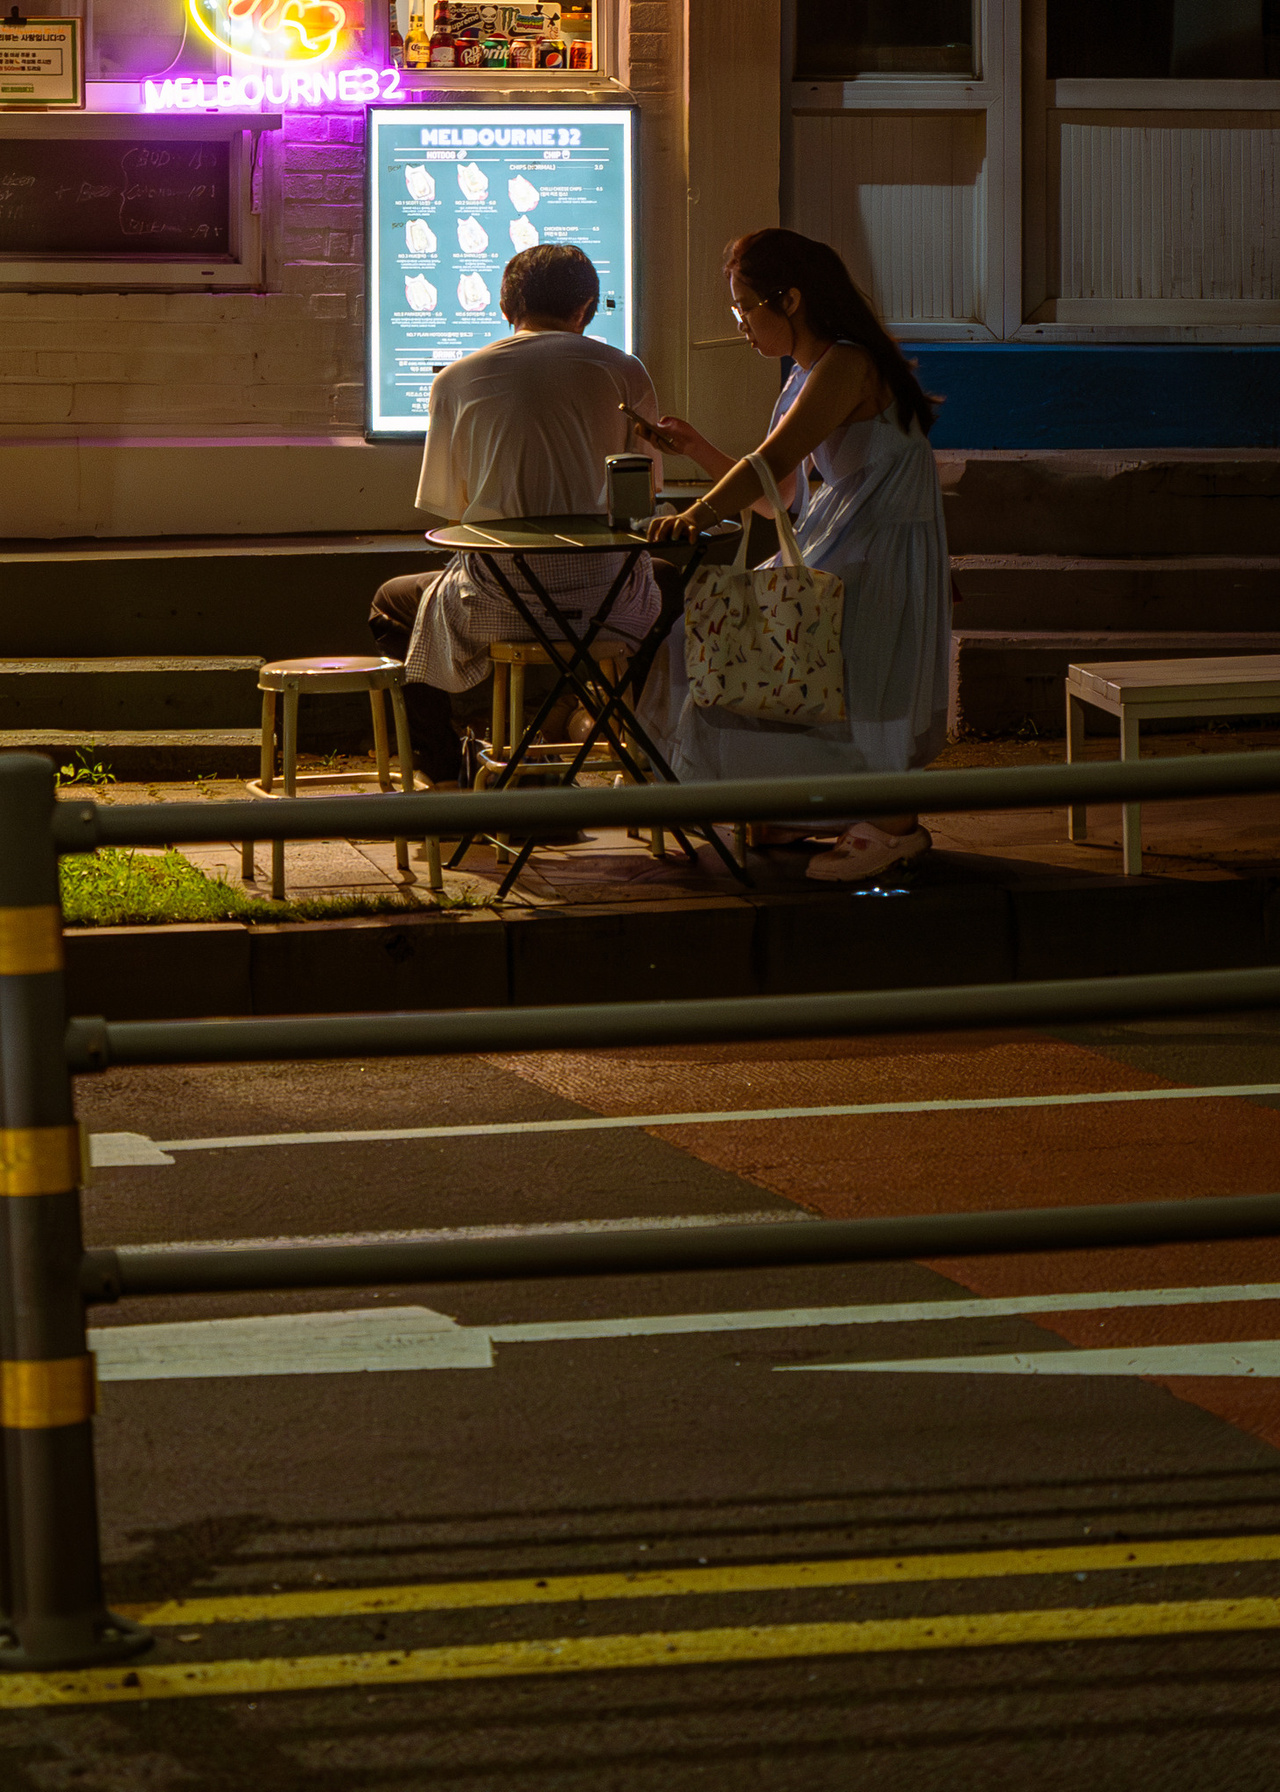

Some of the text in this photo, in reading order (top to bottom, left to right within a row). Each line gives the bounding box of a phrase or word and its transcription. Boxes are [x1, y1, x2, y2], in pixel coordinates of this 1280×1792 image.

[421, 127, 582, 146] MELBOURNE 32
[426, 151, 562, 159] HOTDOG CHIP
